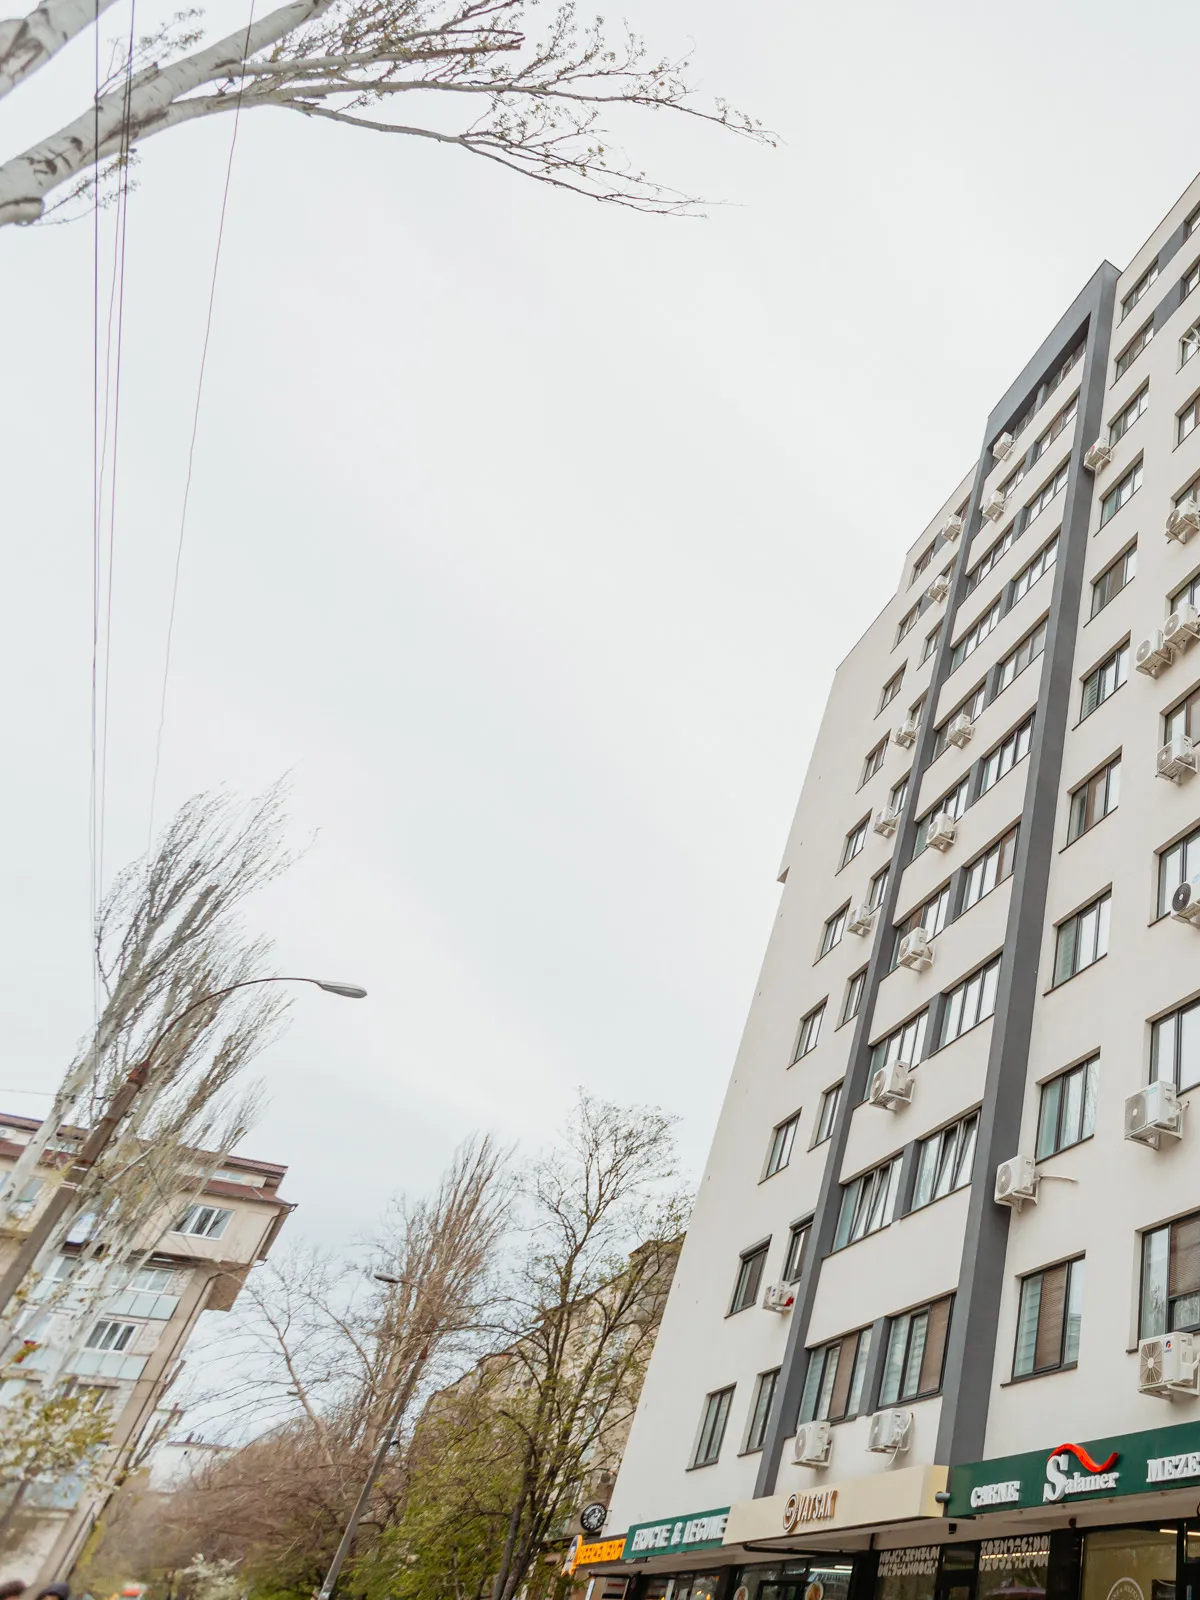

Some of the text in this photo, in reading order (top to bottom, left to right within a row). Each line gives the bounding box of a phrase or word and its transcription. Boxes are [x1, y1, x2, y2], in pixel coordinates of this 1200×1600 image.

[1043, 1454, 1120, 1502] Salamer
[970, 1481, 1021, 1508] CARNE
[671, 1522, 683, 1545] &
